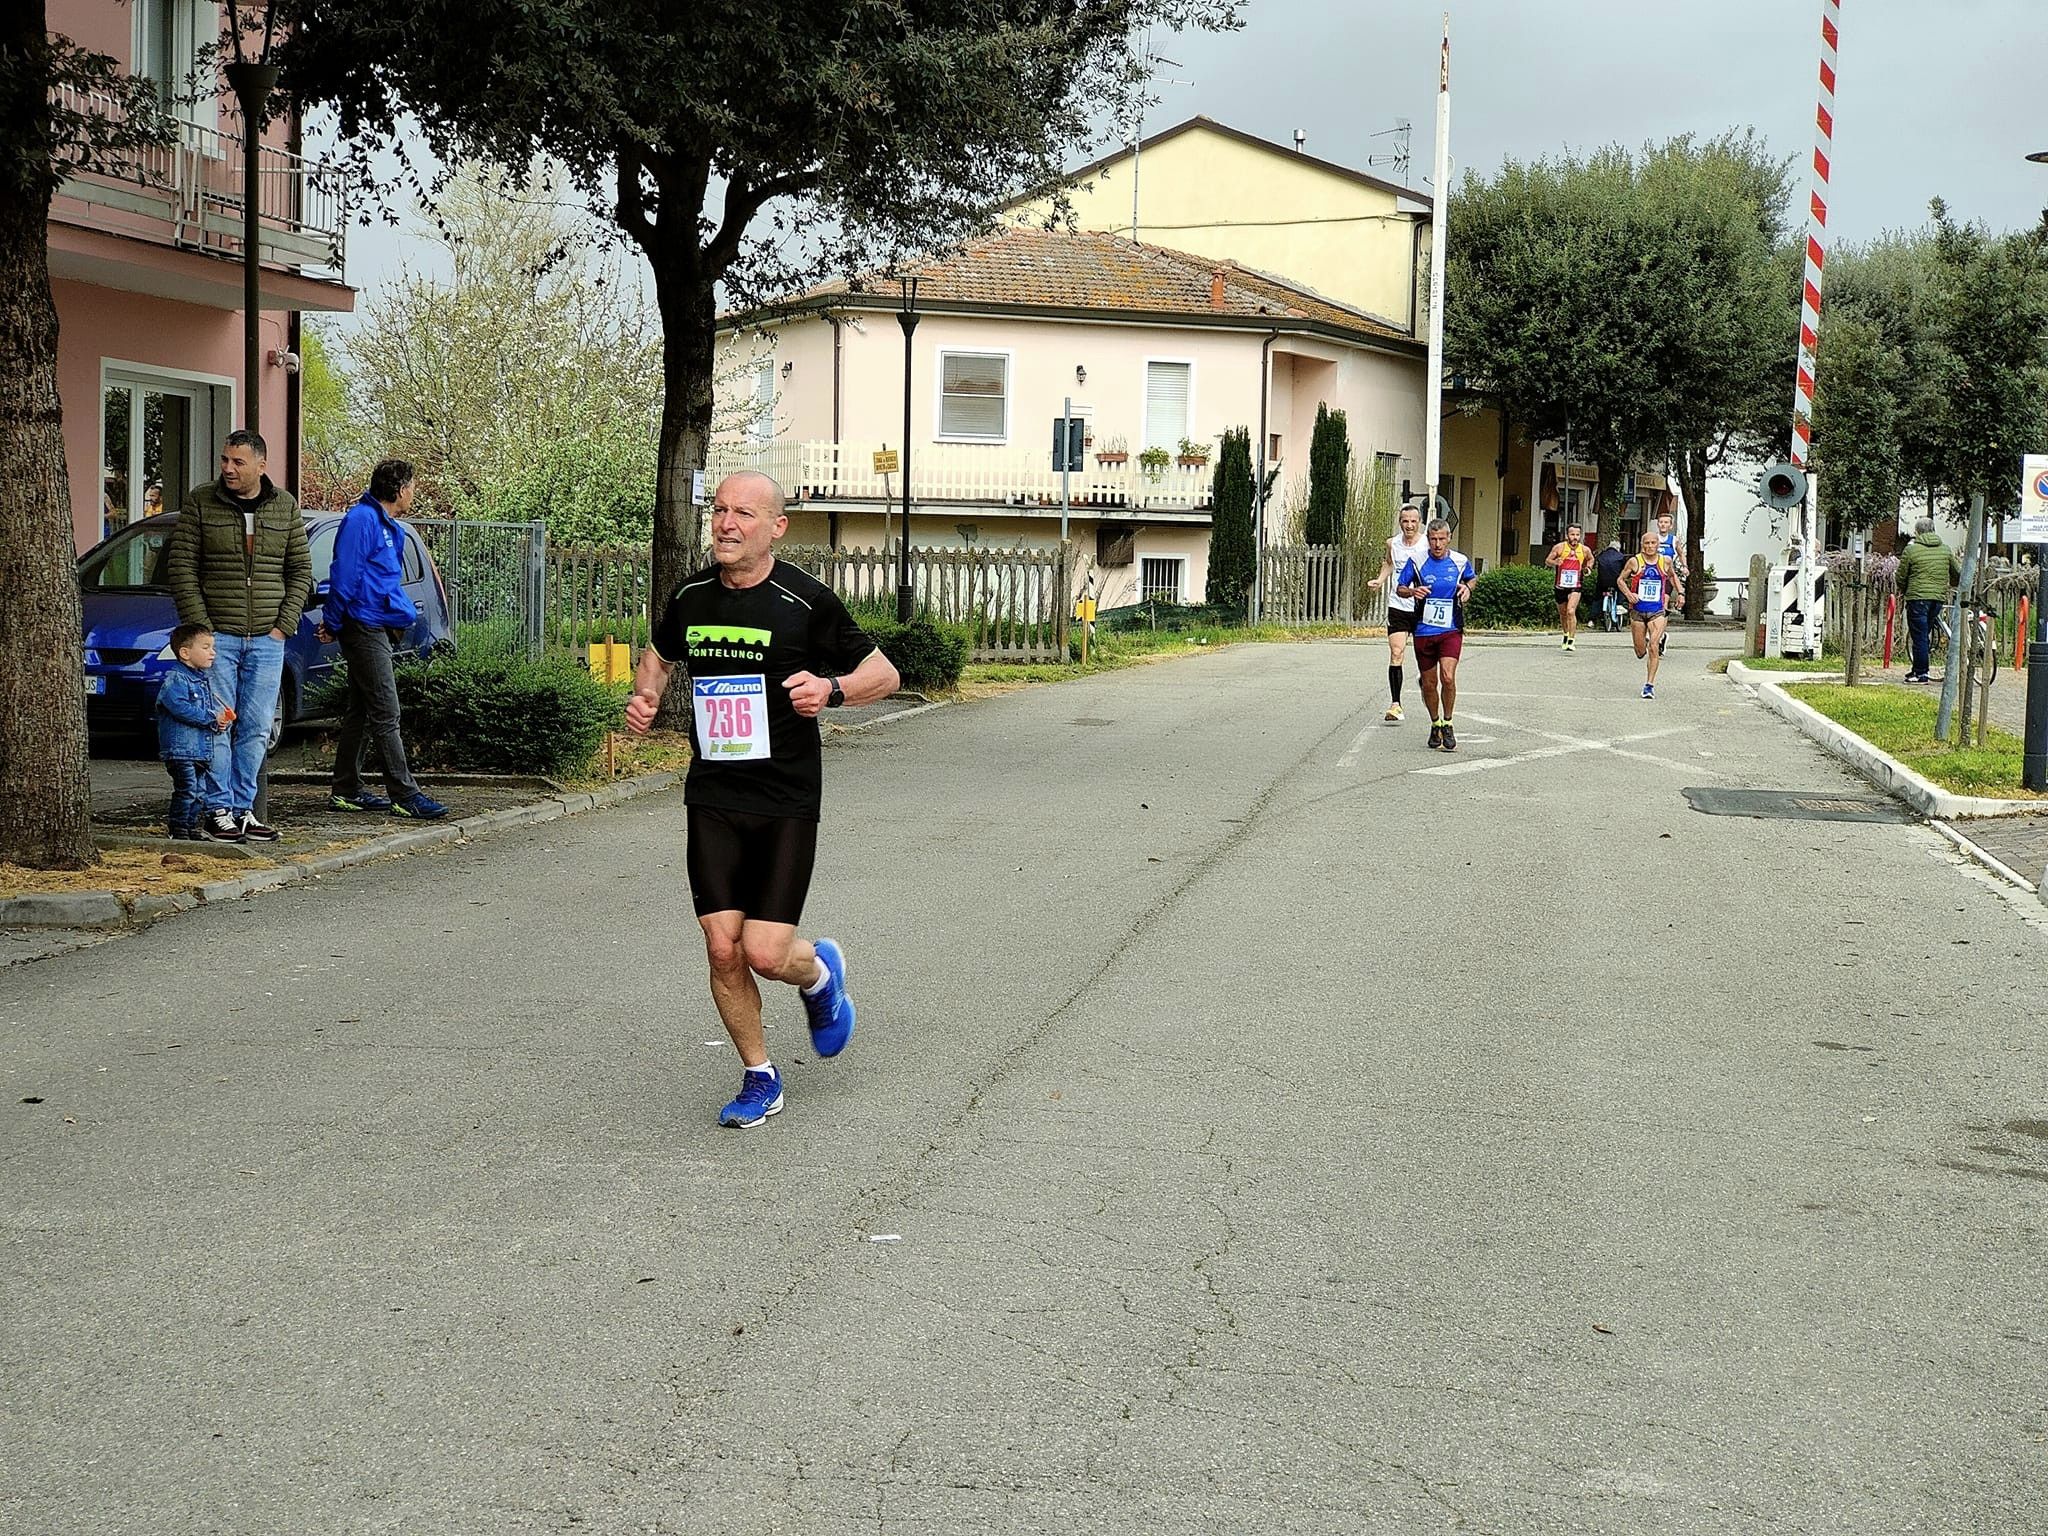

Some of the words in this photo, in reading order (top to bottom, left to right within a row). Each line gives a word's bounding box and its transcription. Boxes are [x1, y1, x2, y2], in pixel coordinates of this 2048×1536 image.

[1561, 466, 1596, 480] TBACCHERIA
[1644, 585, 1657, 596] 189
[1433, 606, 1445, 620] 75
[688, 648, 764, 661] PONTELUNGO
[705, 697, 753, 738] 236
